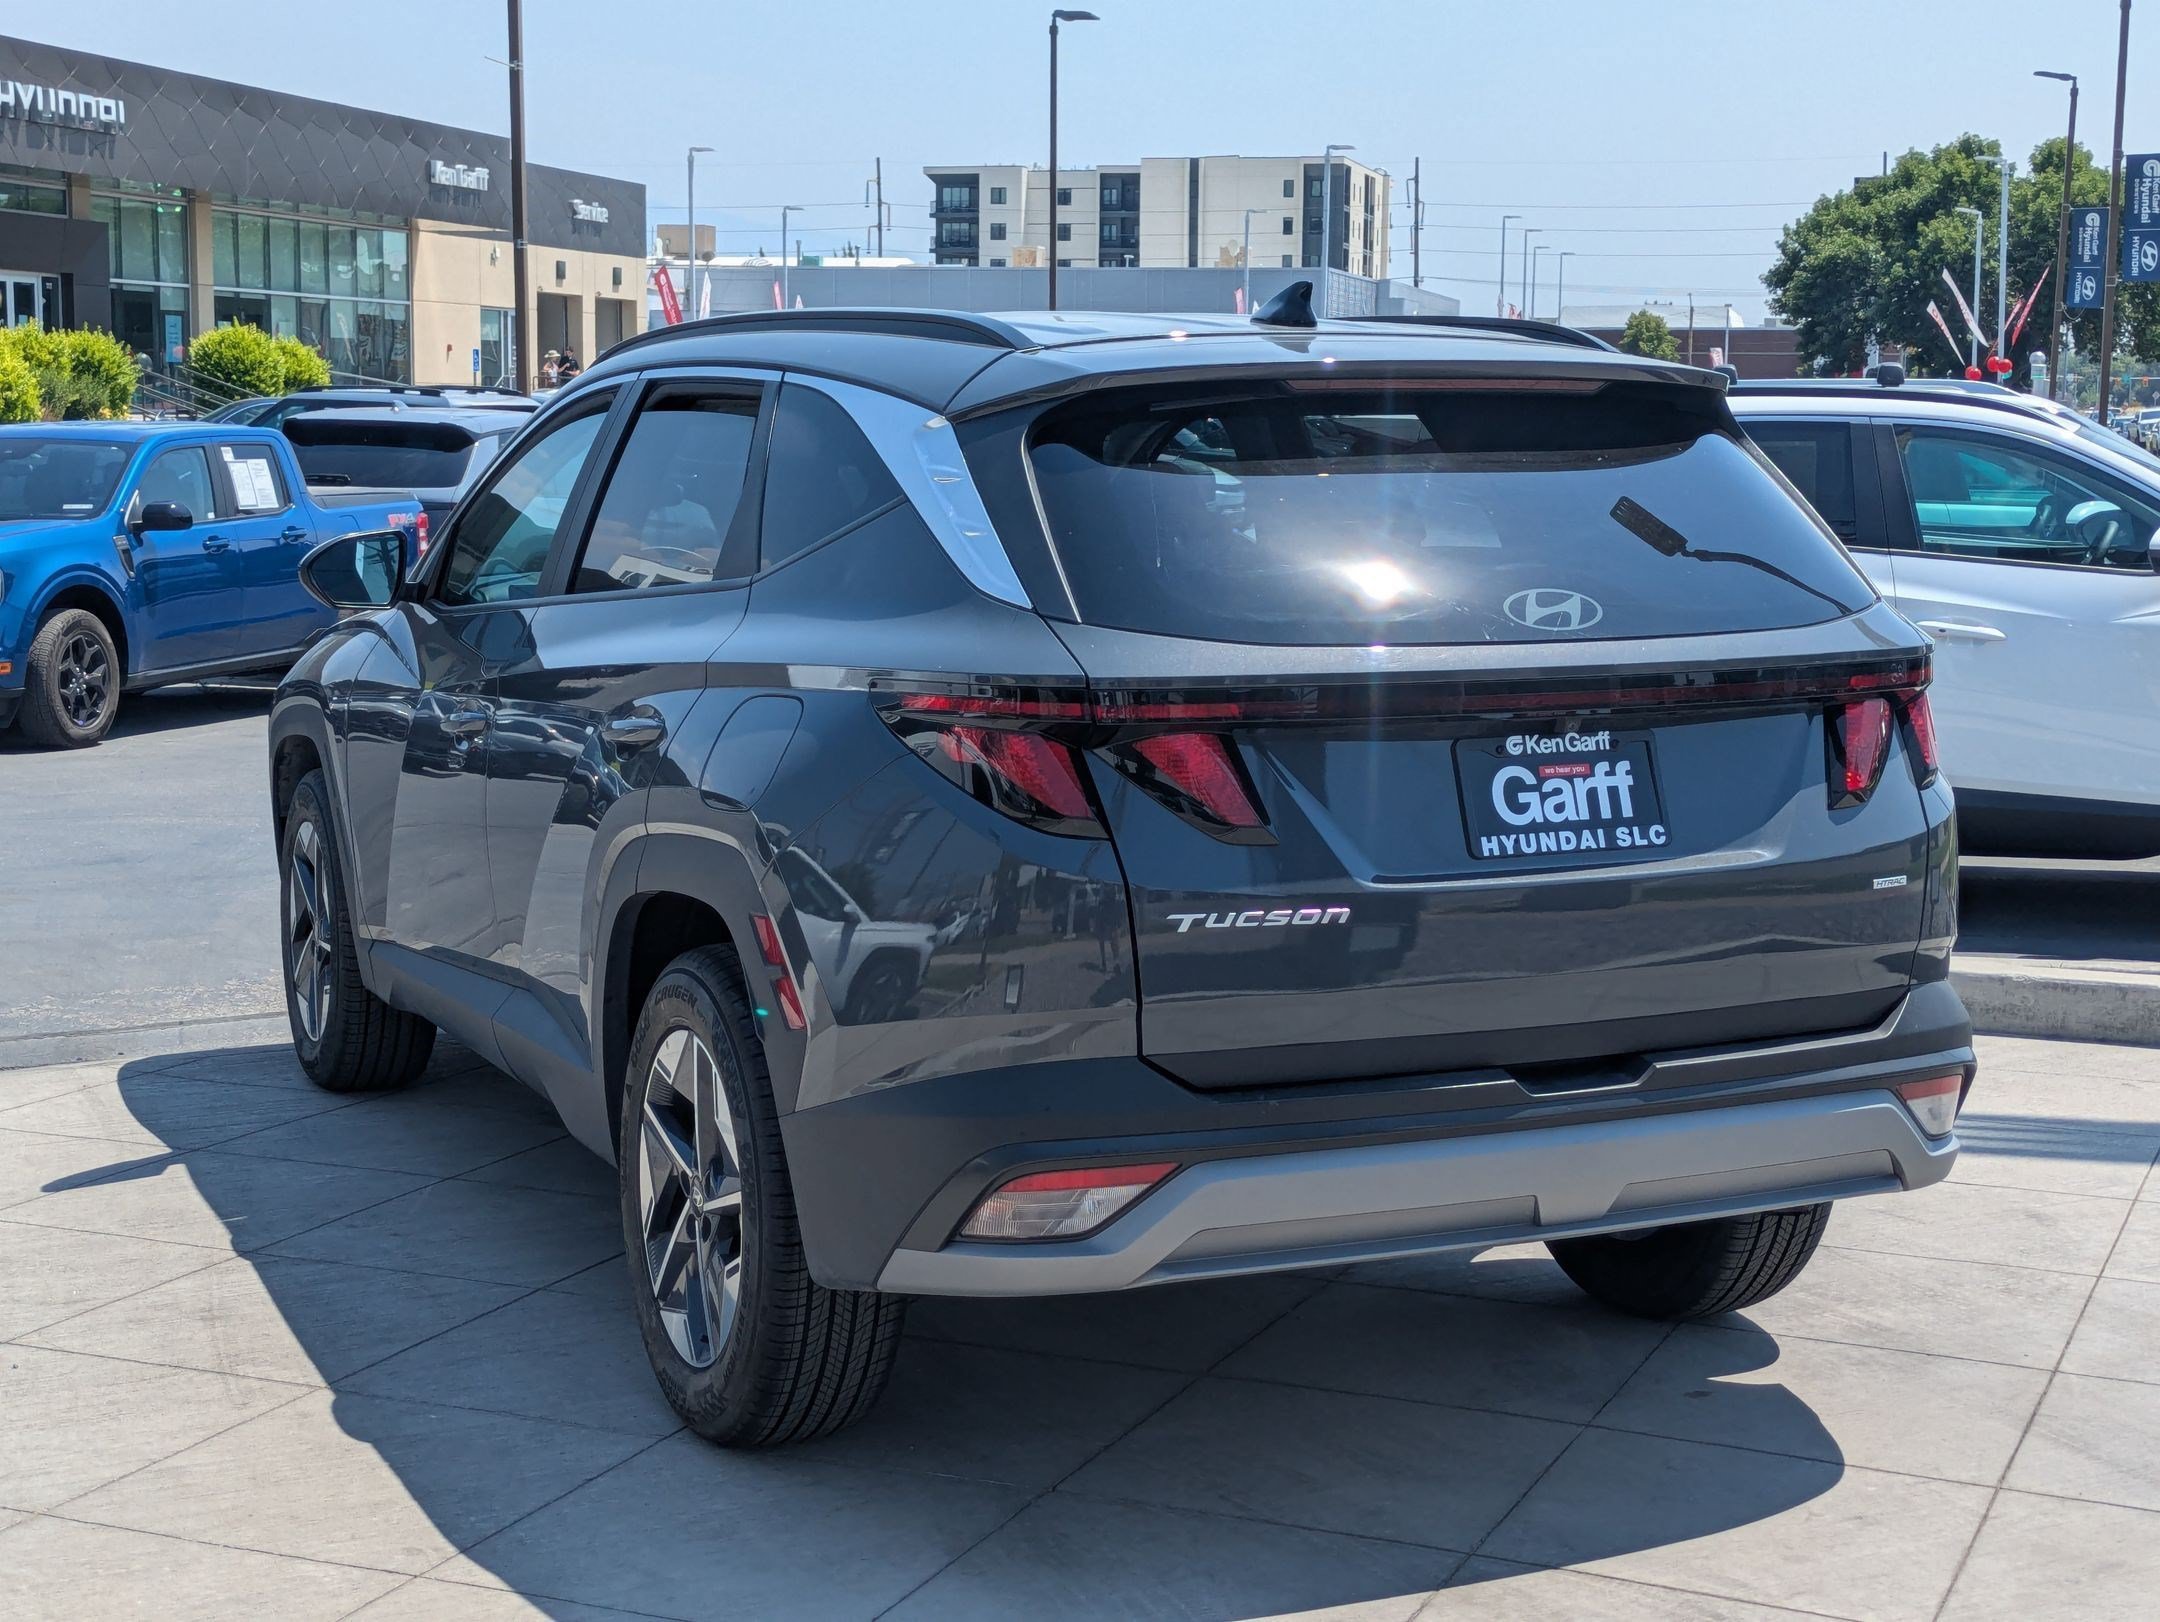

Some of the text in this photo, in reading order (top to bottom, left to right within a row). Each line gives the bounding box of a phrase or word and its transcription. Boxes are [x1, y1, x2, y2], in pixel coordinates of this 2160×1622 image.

[0, 80, 125, 124] HYUNDAI
[569, 199, 608, 223] Service
[2141, 178, 2151, 223] Hyundai
[2131, 236, 2140, 276] HYUNDAI
[1526, 731, 1610, 755] Ken Garff
[1556, 765, 1571, 774] hear
[1572, 765, 1585, 774] you
[1492, 760, 1634, 826] Garff
[1480, 824, 1667, 857] HYUNDAI SLC
[1166, 907, 1351, 933] TUCSON
